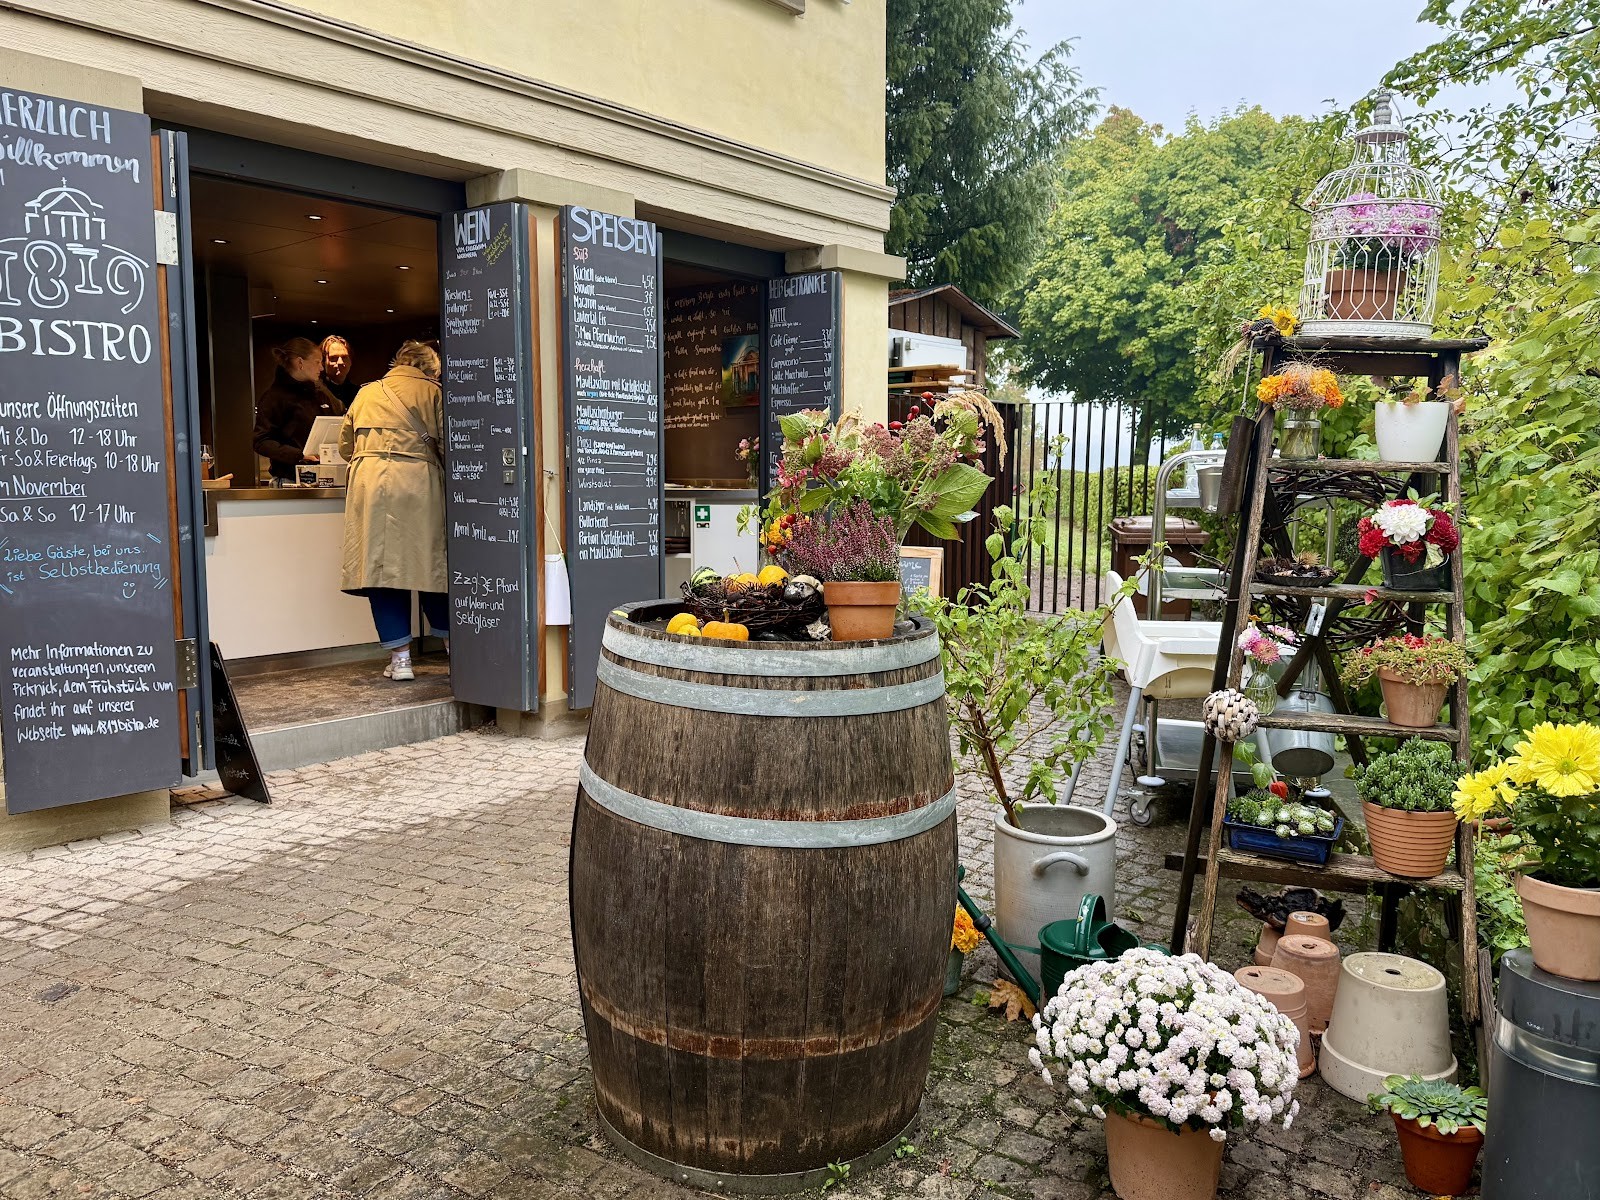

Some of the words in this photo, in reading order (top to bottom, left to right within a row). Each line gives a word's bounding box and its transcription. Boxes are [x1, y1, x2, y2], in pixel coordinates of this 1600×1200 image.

[0, 92, 111, 144] ERZLICH
[453, 208, 491, 247] WEIN
[570, 205, 657, 257] SPEISEN
[573, 264, 594, 282] Kuchen
[573, 281, 596, 296] Brownie
[643, 290, 654, 304] 3€
[573, 295, 597, 310] Macaron
[598, 311, 607, 326] Eis
[0, 316, 151, 364] BISTRO
[592, 326, 627, 345] Pfannkuchen
[770, 333, 783, 348] Café
[575, 374, 611, 391] Maultaschen
[611, 377, 621, 391] mit
[621, 378, 652, 394] Kartoffelsalat
[771, 370, 784, 382] Latte
[784, 367, 809, 380] Macchiato
[0, 400, 42, 419] unsere
[47, 391, 139, 423] Öffnungszeiten
[576, 404, 625, 420] Maultaschenburger
[771, 397, 792, 410] Espresso
[15, 426, 28, 446] &
[31, 427, 48, 446] Do
[115, 429, 138, 448] Uhr
[141, 454, 161, 473] Uhr
[586, 456, 602, 464] Pinsa
[13, 474, 87, 498] November
[578, 478, 612, 489] Wurstsalat
[0, 506, 20, 523] Sa
[23, 505, 34, 523] &
[38, 506, 57, 523] So
[114, 504, 137, 524] Uhr
[578, 497, 606, 514] Landjäger
[578, 530, 599, 546] Portion
[600, 530, 636, 547] Kartoffelsalat
[4, 549, 44, 563] Liebe
[47, 544, 91, 560] Gäste,
[93, 543, 112, 558] bei
[7, 572, 25, 583] ist
[39, 558, 162, 580] Selbstbedienung
[496, 577, 519, 595] Pfand
[455, 596, 468, 608] auf
[456, 611, 501, 634] Sektgläser
[11, 645, 42, 662] Mehr
[46, 641, 134, 661] Informationen
[137, 645, 154, 657] zu
[13, 680, 62, 698] Picknick,
[63, 680, 88, 694] dem
[88, 677, 150, 694] Frühstück
[153, 680, 175, 693] uvm
[13, 701, 47, 722] findet
[51, 701, 66, 717] ihr
[73, 698, 94, 716] auf
[98, 699, 135, 713] unserer
[17, 722, 67, 744] Webseite
